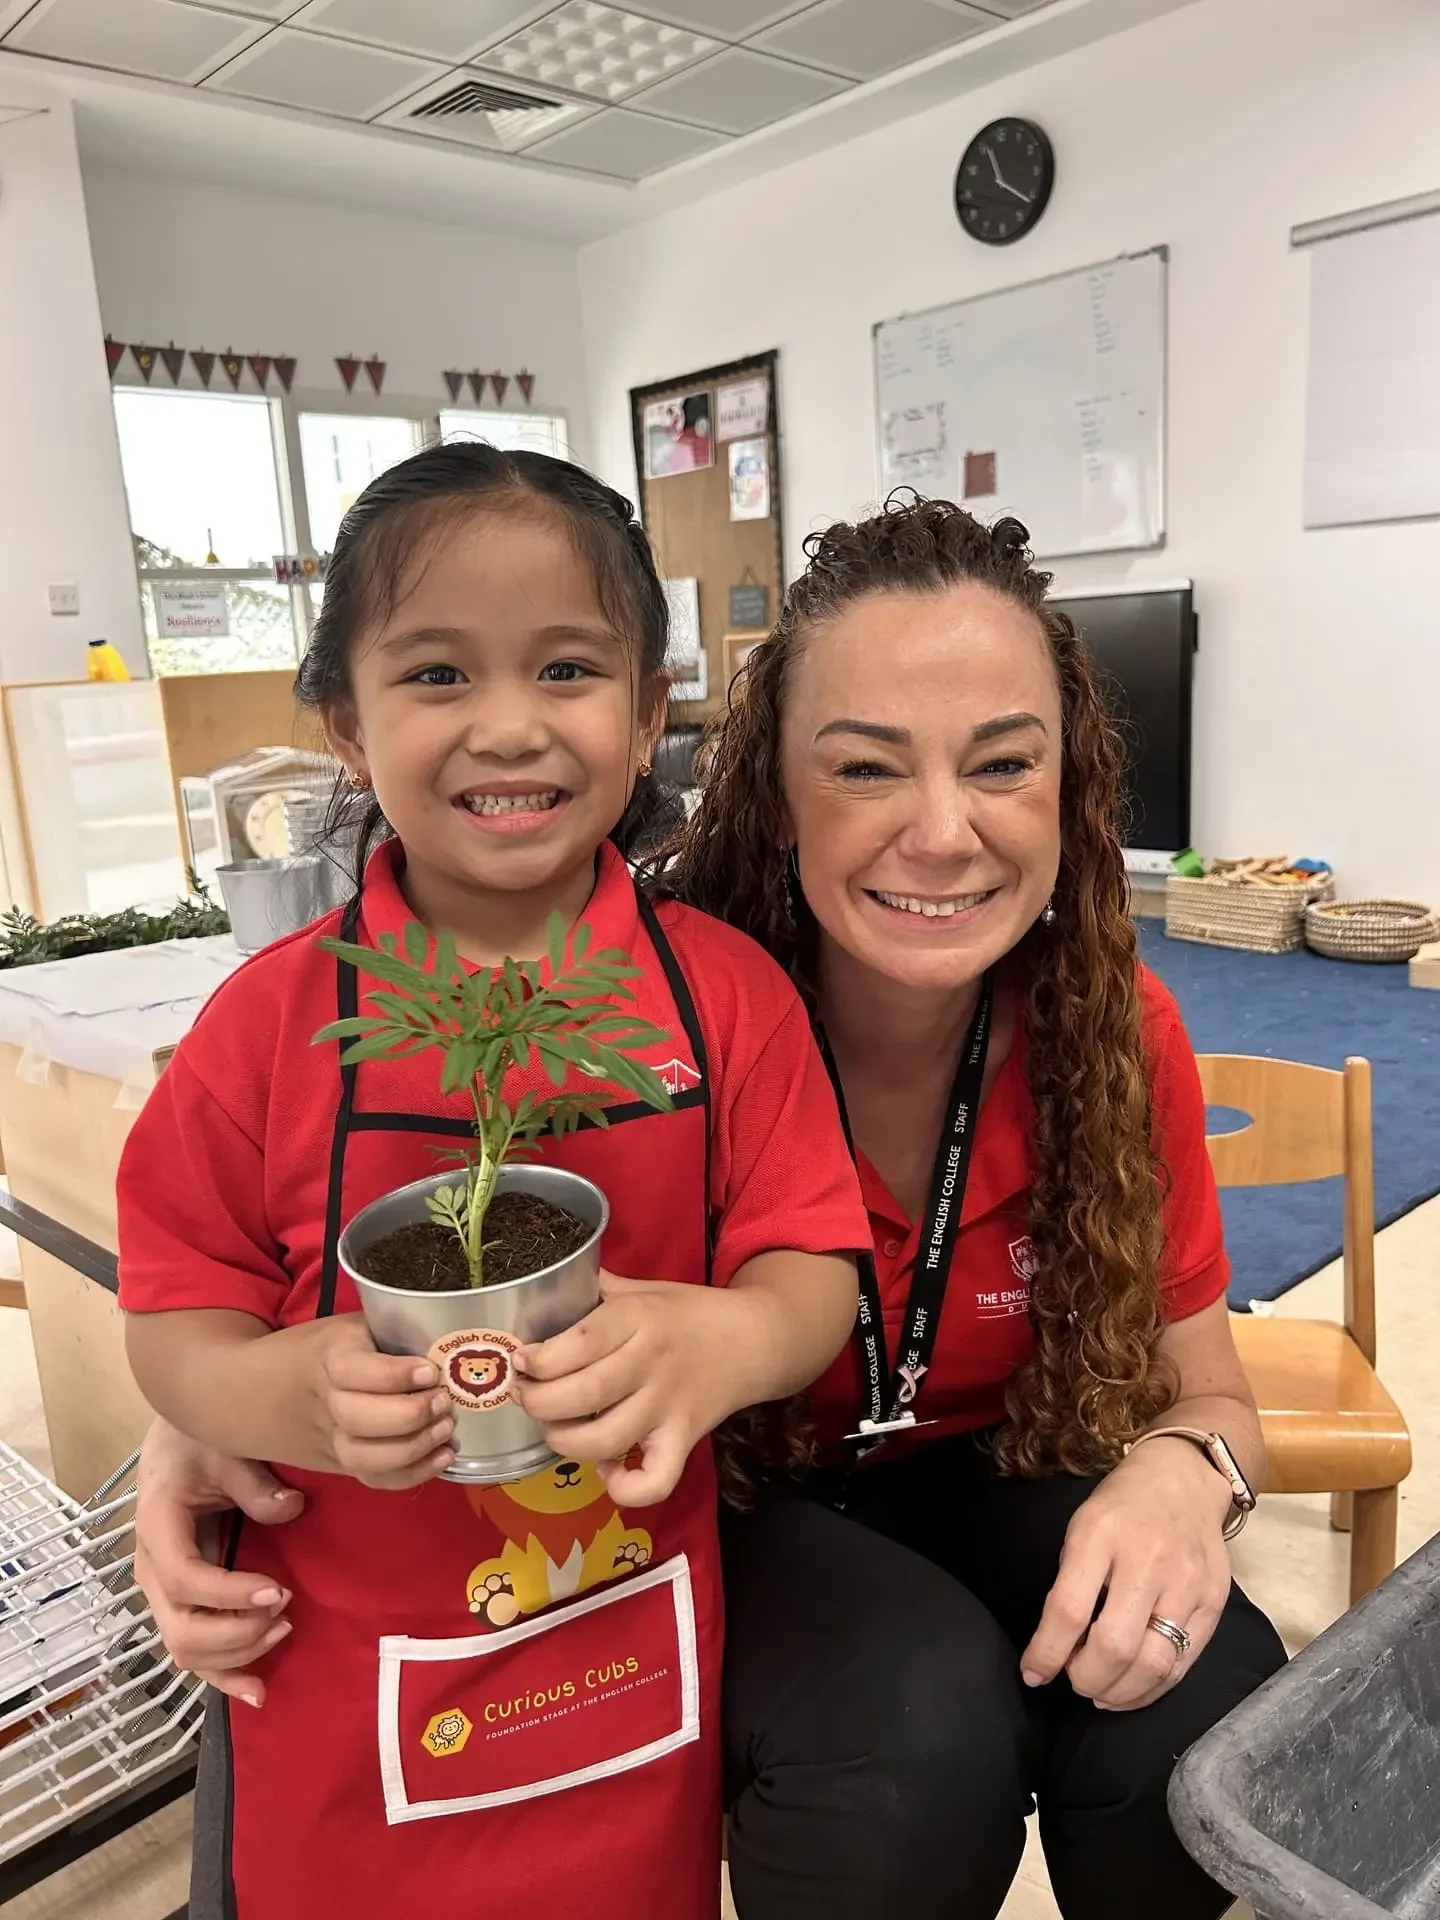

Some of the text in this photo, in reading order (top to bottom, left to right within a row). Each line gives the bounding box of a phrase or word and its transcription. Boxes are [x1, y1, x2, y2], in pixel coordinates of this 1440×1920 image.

[969, 1043, 982, 1065] THE
[954, 1102, 969, 1134] STAFF
[926, 1144, 962, 1270] THE ENGLISH COLLEGE
[975, 1292, 998, 1305] THE
[912, 1307, 929, 1339] STAFF
[438, 1333, 517, 1354] English Colleg
[858, 1293, 881, 1422] NGLISH COLLEGE STAFF
[483, 1391, 512, 1409] Cubs
[484, 1656, 640, 1723] Curious Cubs
[486, 1668, 669, 1741] FOUNDATION STAGE AT THE ENGLISH COLLEGE
